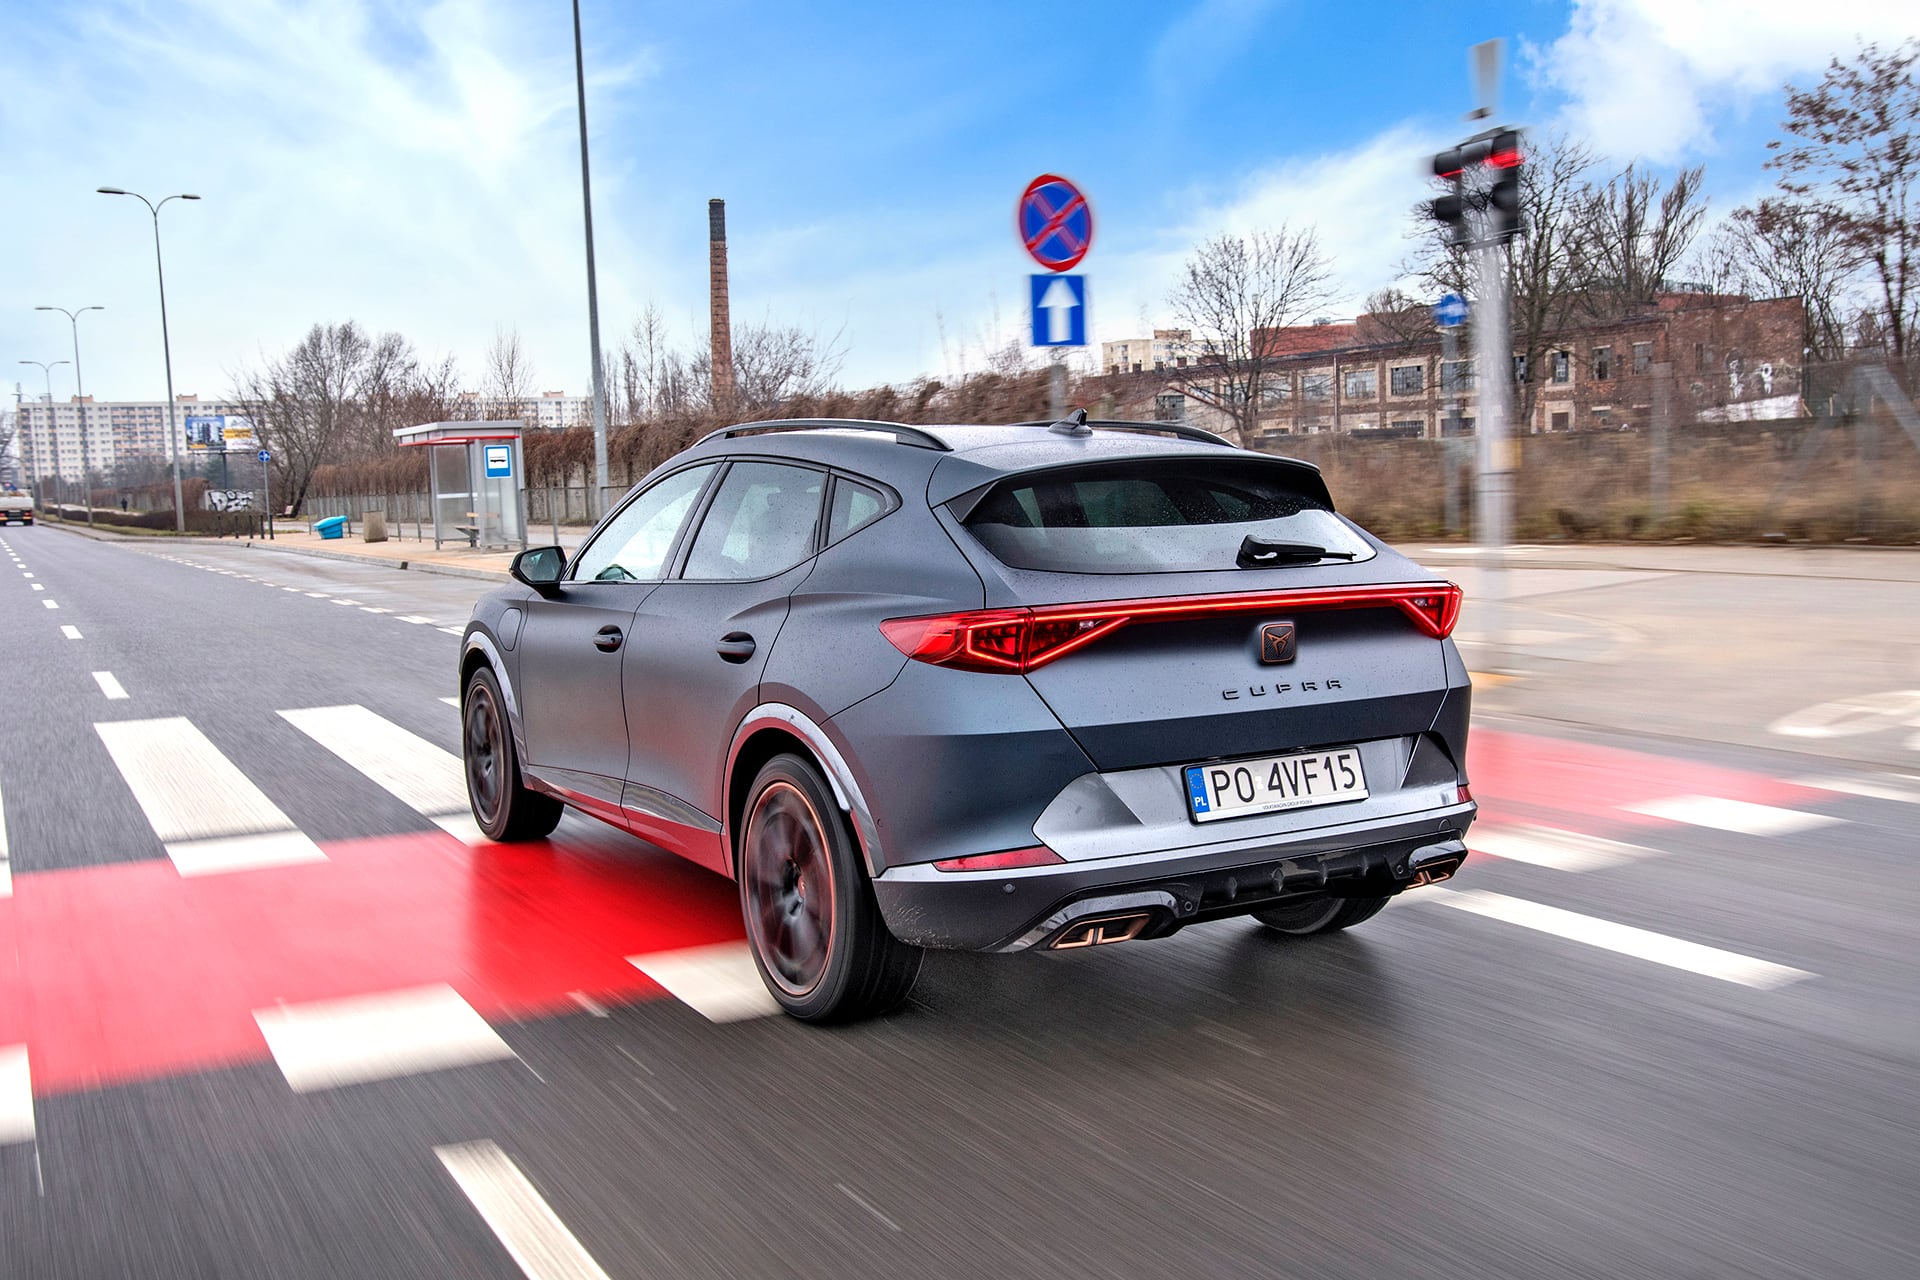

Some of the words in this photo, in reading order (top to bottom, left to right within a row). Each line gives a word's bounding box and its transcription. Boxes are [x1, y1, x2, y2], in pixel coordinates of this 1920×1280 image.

[1222, 679, 1342, 700] CUPRA
[1210, 766, 1256, 807] PO
[1267, 753, 1356, 798] 4VF15
[1194, 796, 1207, 807] PL
